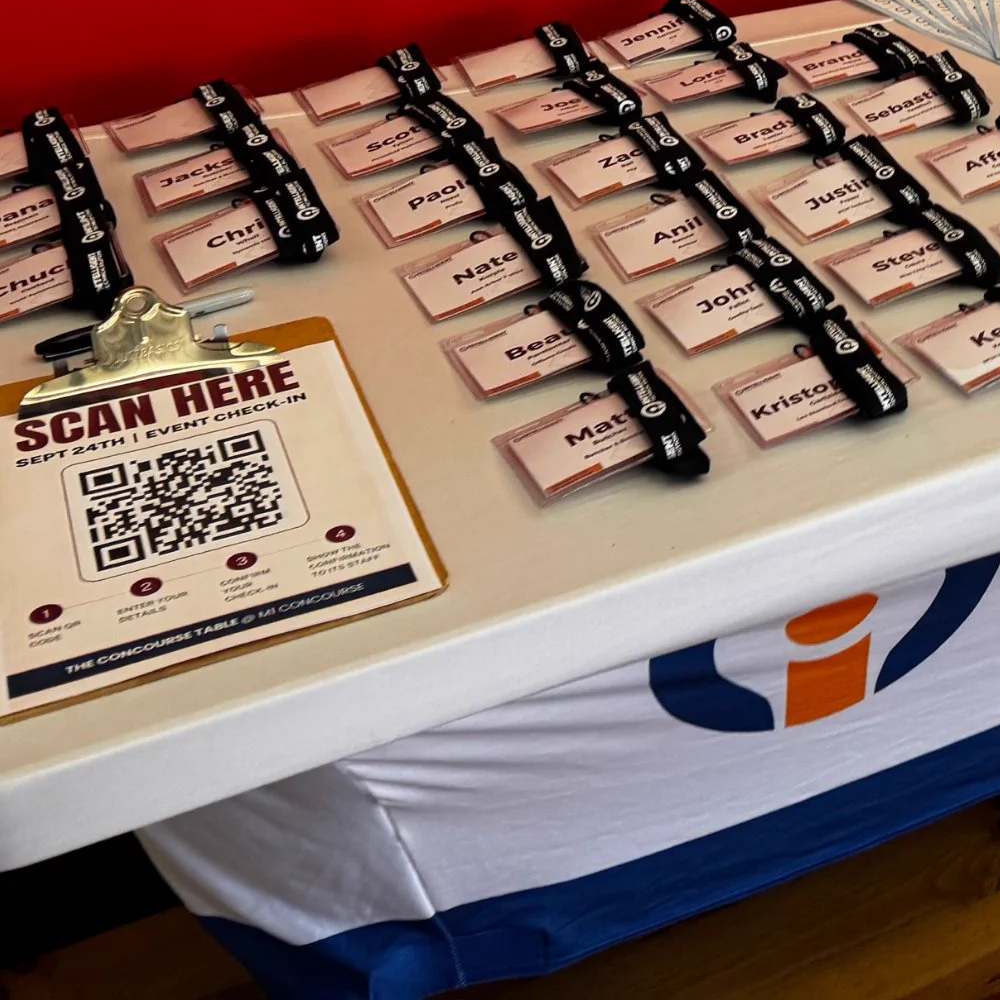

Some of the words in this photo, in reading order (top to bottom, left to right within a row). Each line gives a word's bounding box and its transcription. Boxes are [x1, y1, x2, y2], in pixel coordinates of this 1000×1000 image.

[0, 199, 55, 222] ana
[653, 215, 704, 245] Anil
[453, 251, 518, 286] Nate
[872, 241, 941, 273] Steve
[14, 393, 156, 452] SCAN
[171, 360, 300, 418] HERE
[16, 449, 69, 468] SEPT
[72, 437, 125, 461] 24TH
[146, 417, 210, 439] EVENT
[214, 392, 307, 422] CHECK-IN
[335, 529, 346, 538] 4
[235, 556, 248, 566] 3
[140, 582, 153, 593] 2
[42, 609, 50, 619] 1
[118, 605, 168, 624] DETAILS
[28, 624, 62, 639] SCAN
[64, 659, 95, 675] THE
[97, 631, 193, 665] CONCOURSE
[193, 617, 239, 637] TABLE
[241, 614, 257, 626] @
[278, 582, 365, 613] CONCOURSE
